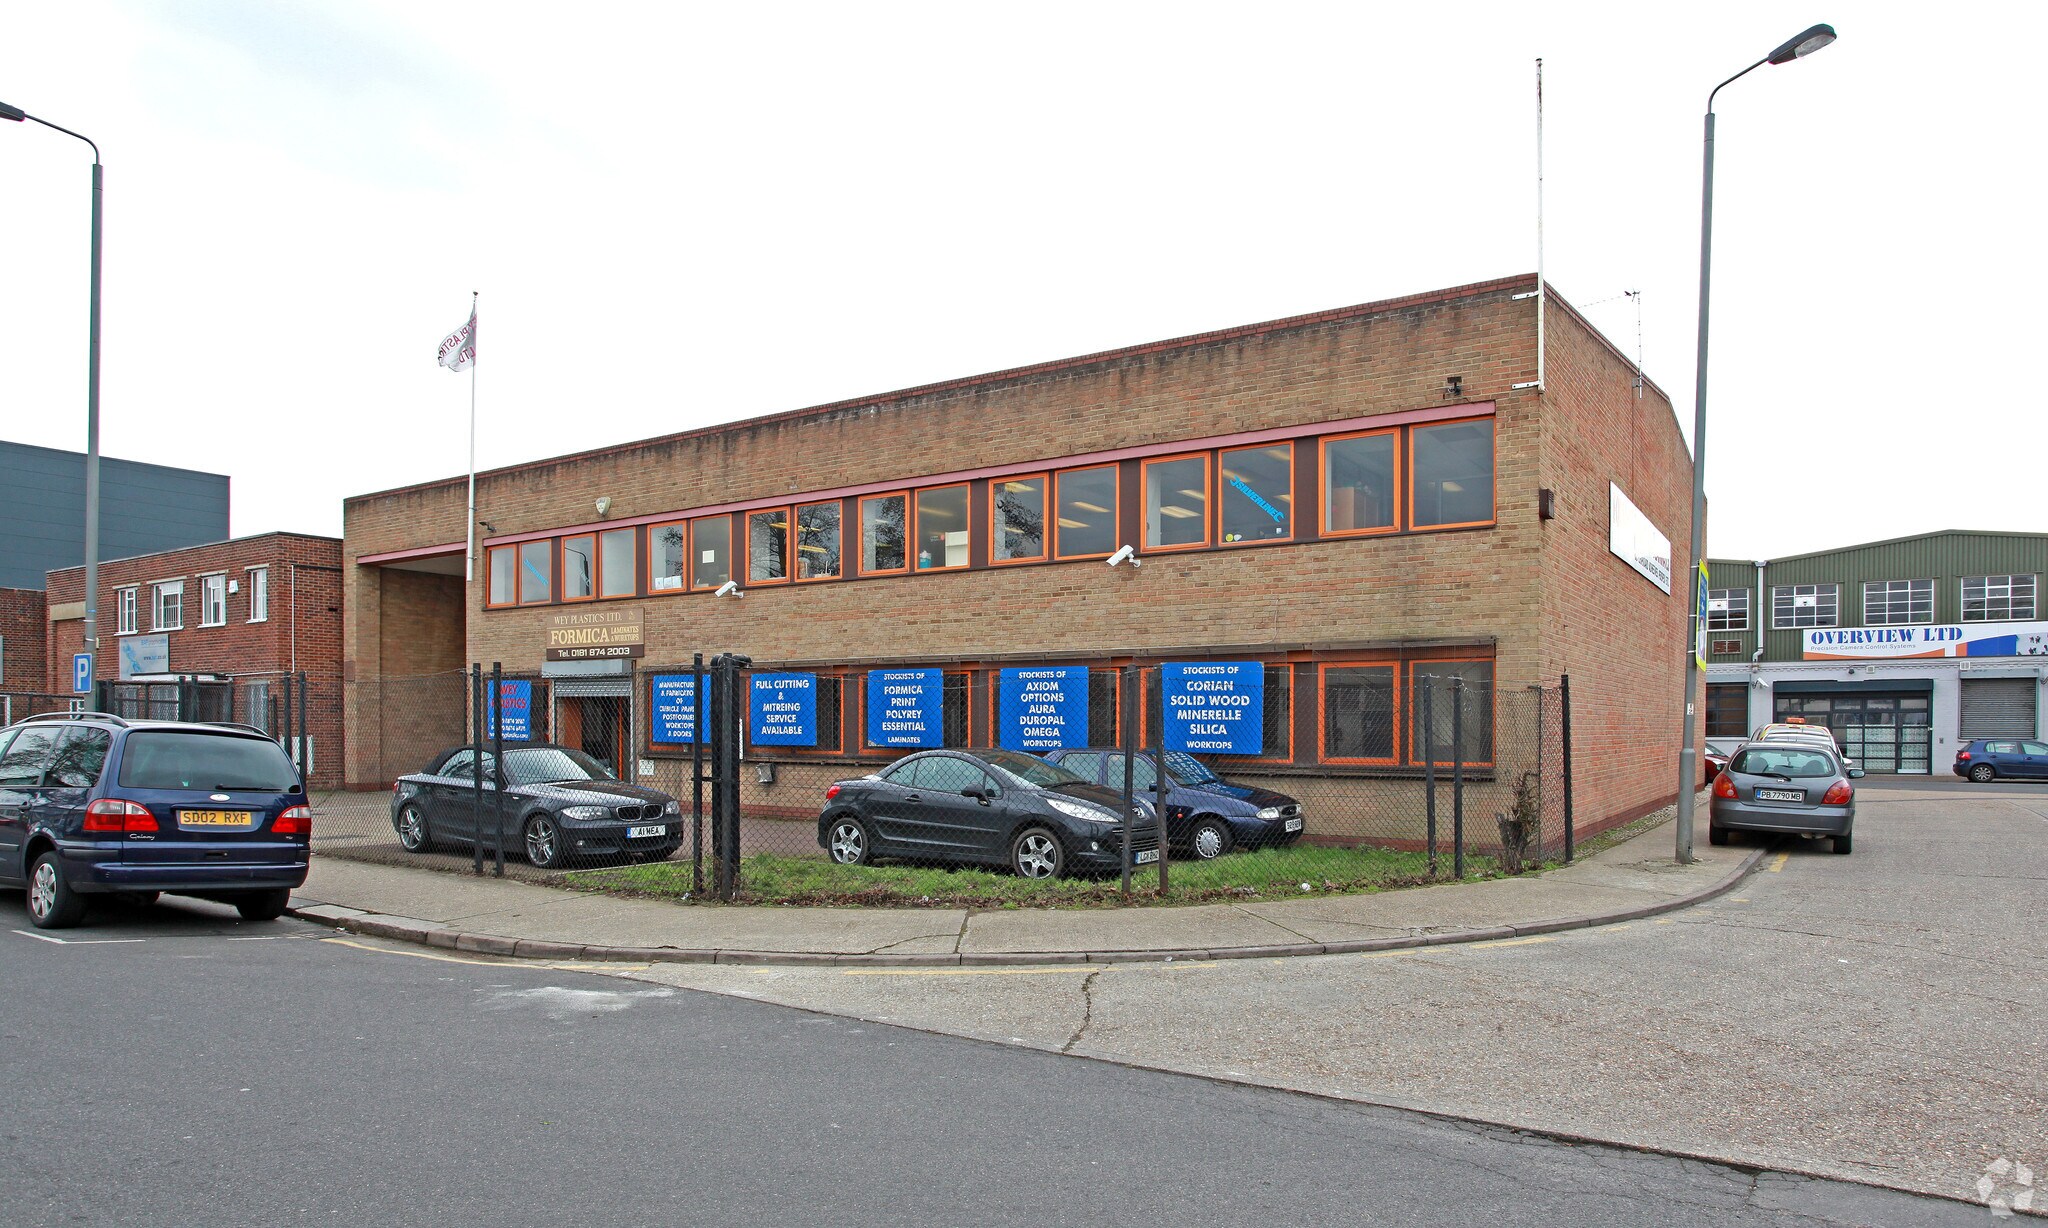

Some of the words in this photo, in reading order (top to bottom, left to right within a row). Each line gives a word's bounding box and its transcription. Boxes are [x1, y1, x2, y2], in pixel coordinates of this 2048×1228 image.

[554, 616, 569, 625] WEY
[571, 613, 604, 624] PLASTICS
[607, 612, 622, 621] LTD.
[611, 626, 639, 634] LAMINATES
[551, 628, 609, 644] FORMICA
[1811, 629, 1915, 644] OVERVIEW
[1923, 628, 1963, 641] LTD
[571, 649, 587, 657] 0181
[589, 648, 605, 656] 874
[607, 647, 630, 655] 2003
[77, 658, 89, 689] P
[1018, 671, 1054, 679] STOCKISTS
[1183, 666, 1225, 674] STOCKISTS
[1227, 666, 1239, 674] OF
[755, 680, 773, 689] FULL
[774, 679, 810, 689] CUTTING
[1026, 681, 1059, 691] AXIOM
[1186, 680, 1234, 691] CORIAN
[884, 685, 923, 695] FORMICA
[778, 692, 784, 700] &
[1020, 693, 1065, 702] OPTIONS
[1170, 695, 1206, 706] SOLID
[1209, 695, 1250, 706] WOOD
[891, 698, 916, 706] PRINT
[762, 703, 801, 712] MITREING
[1028, 704, 1056, 714] AURA
[766, 714, 797, 723] SERVICE
[886, 710, 922, 719] POLYREY
[1177, 709, 1242, 720] MINERELLE
[1019, 716, 1066, 725] DUROPAL
[761, 726, 803, 735] AVAILABLE
[882, 722, 926, 731] ESSENTIAL
[1189, 724, 1227, 735] SILICA
[1023, 727, 1060, 737] OMEGA
[1186, 741, 1232, 749] WORKTOPS
[183, 812, 217, 823] SD02
[224, 812, 248, 823] RXF
